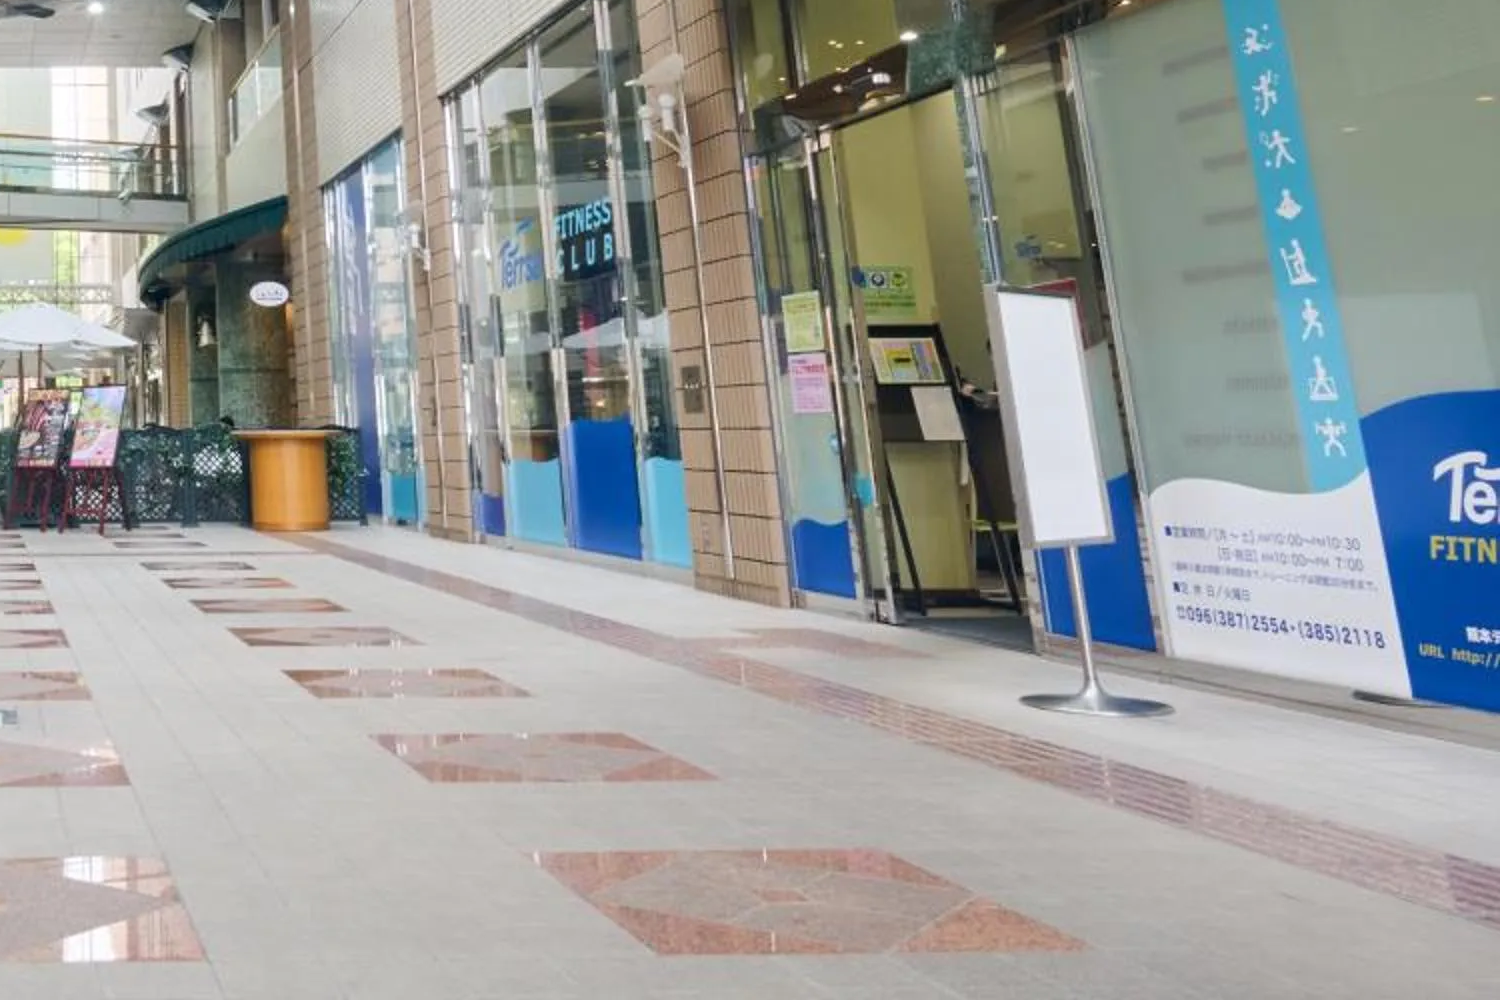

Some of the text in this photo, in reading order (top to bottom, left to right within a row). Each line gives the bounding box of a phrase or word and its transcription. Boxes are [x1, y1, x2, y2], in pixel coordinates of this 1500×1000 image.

[555, 198, 612, 239] FITNESS
[556, 233, 613, 276] CLUB
[1433, 451, 1500, 525] Te
[1429, 535, 1498, 565] FITN
[1419, 642, 1445, 660] URL
